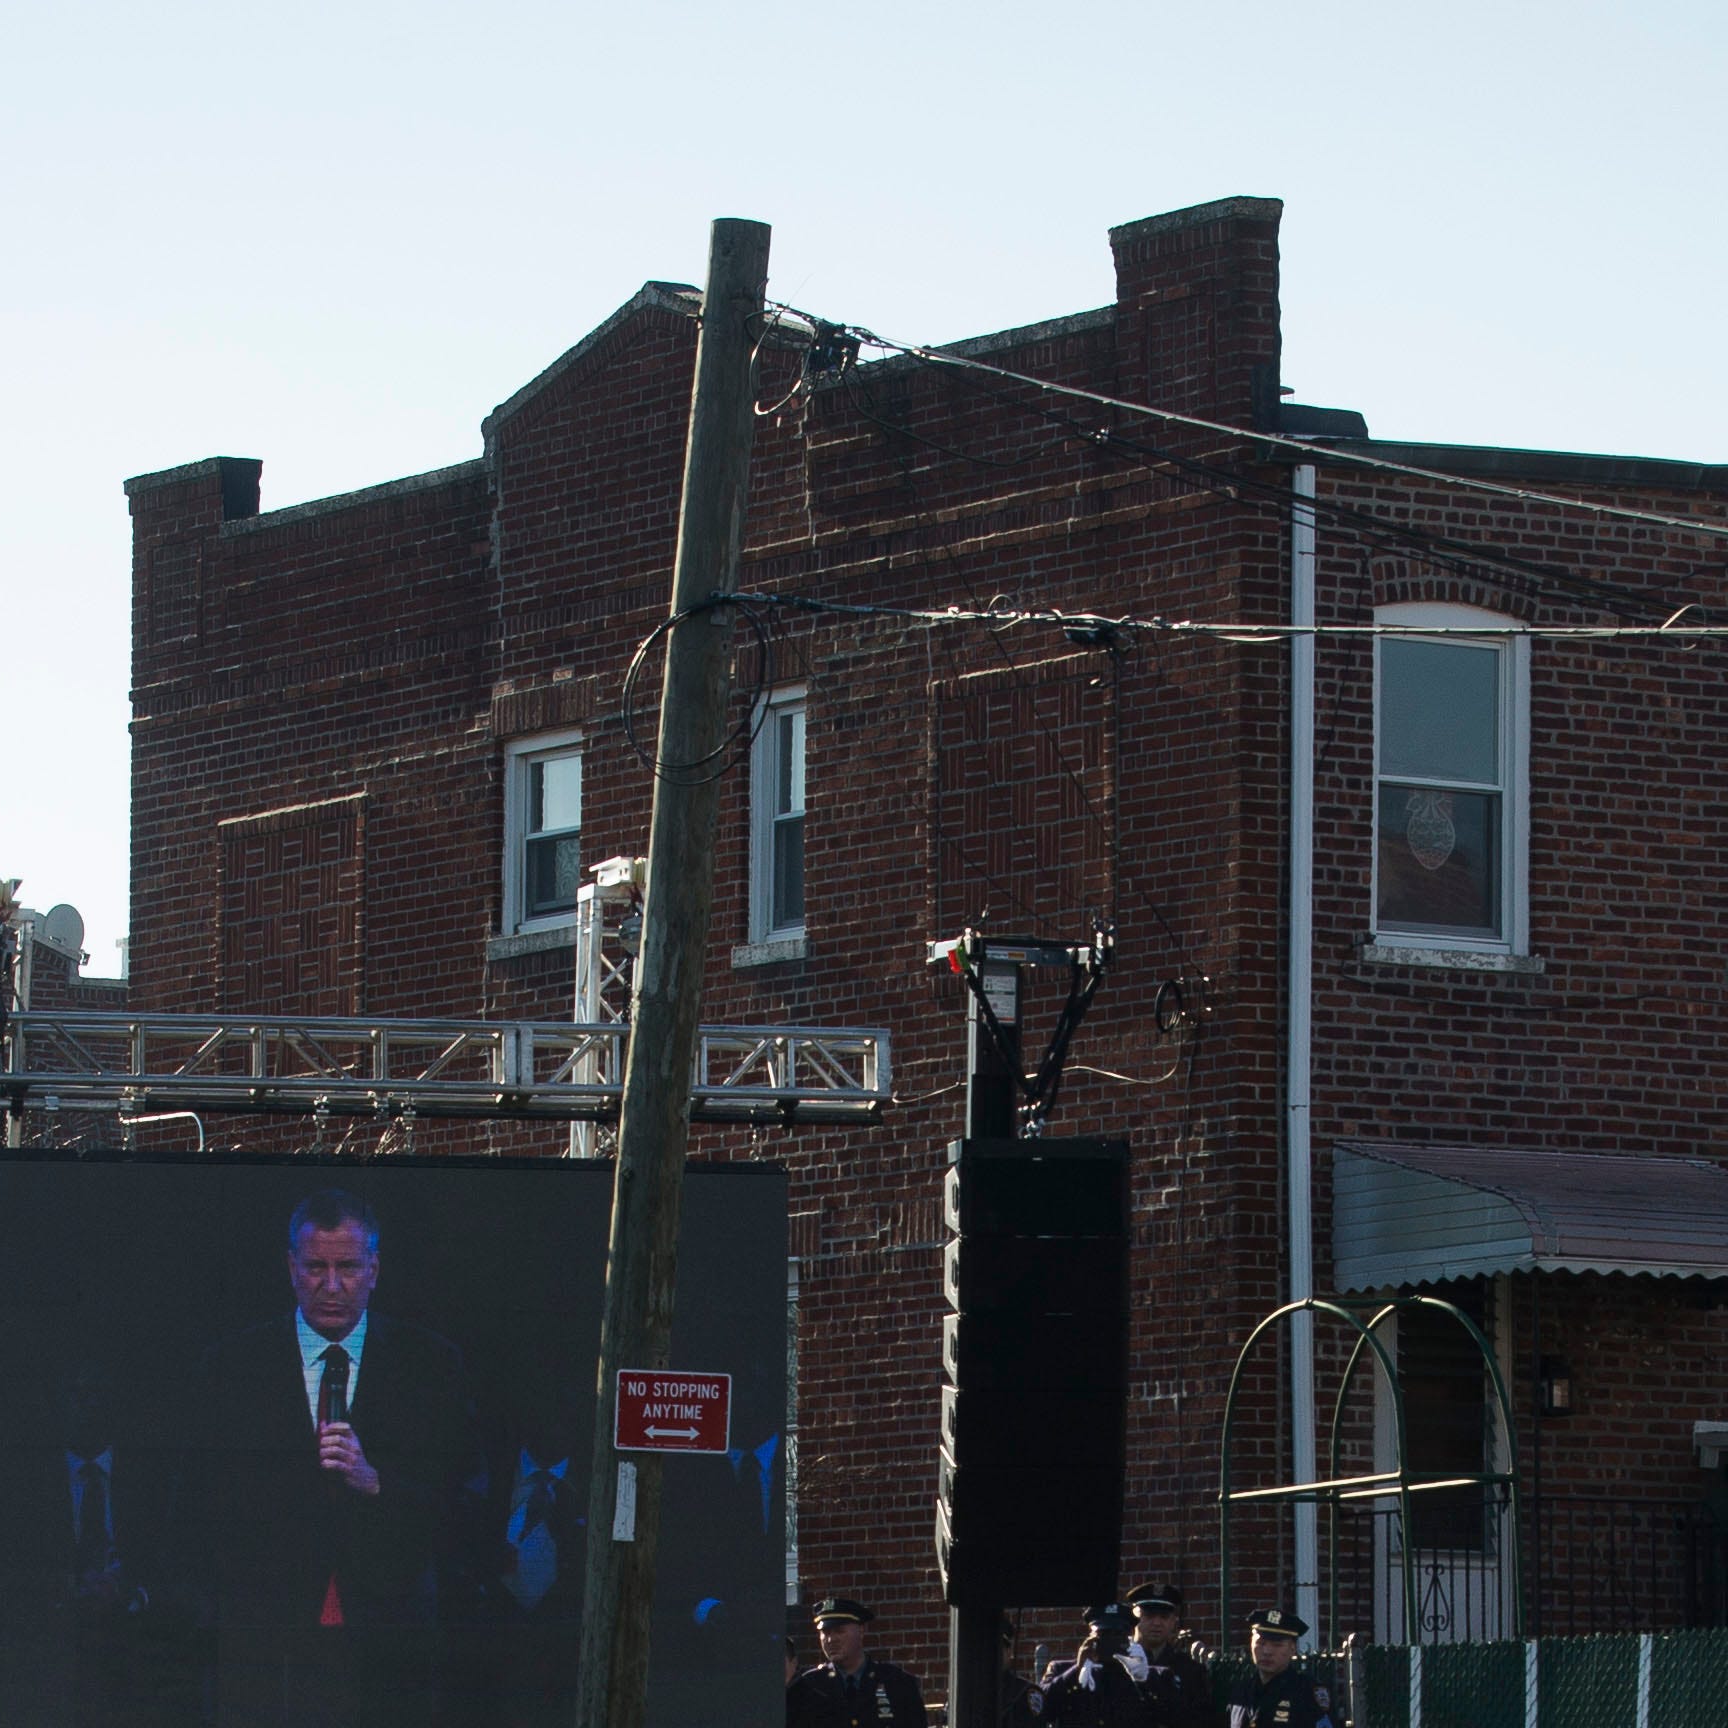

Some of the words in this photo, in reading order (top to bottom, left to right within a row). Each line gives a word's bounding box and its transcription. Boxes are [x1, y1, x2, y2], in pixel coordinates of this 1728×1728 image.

[627, 1381, 647, 1397] NO
[652, 1381, 721, 1400] STOPPING
[642, 1403, 704, 1421] ANYTIME
